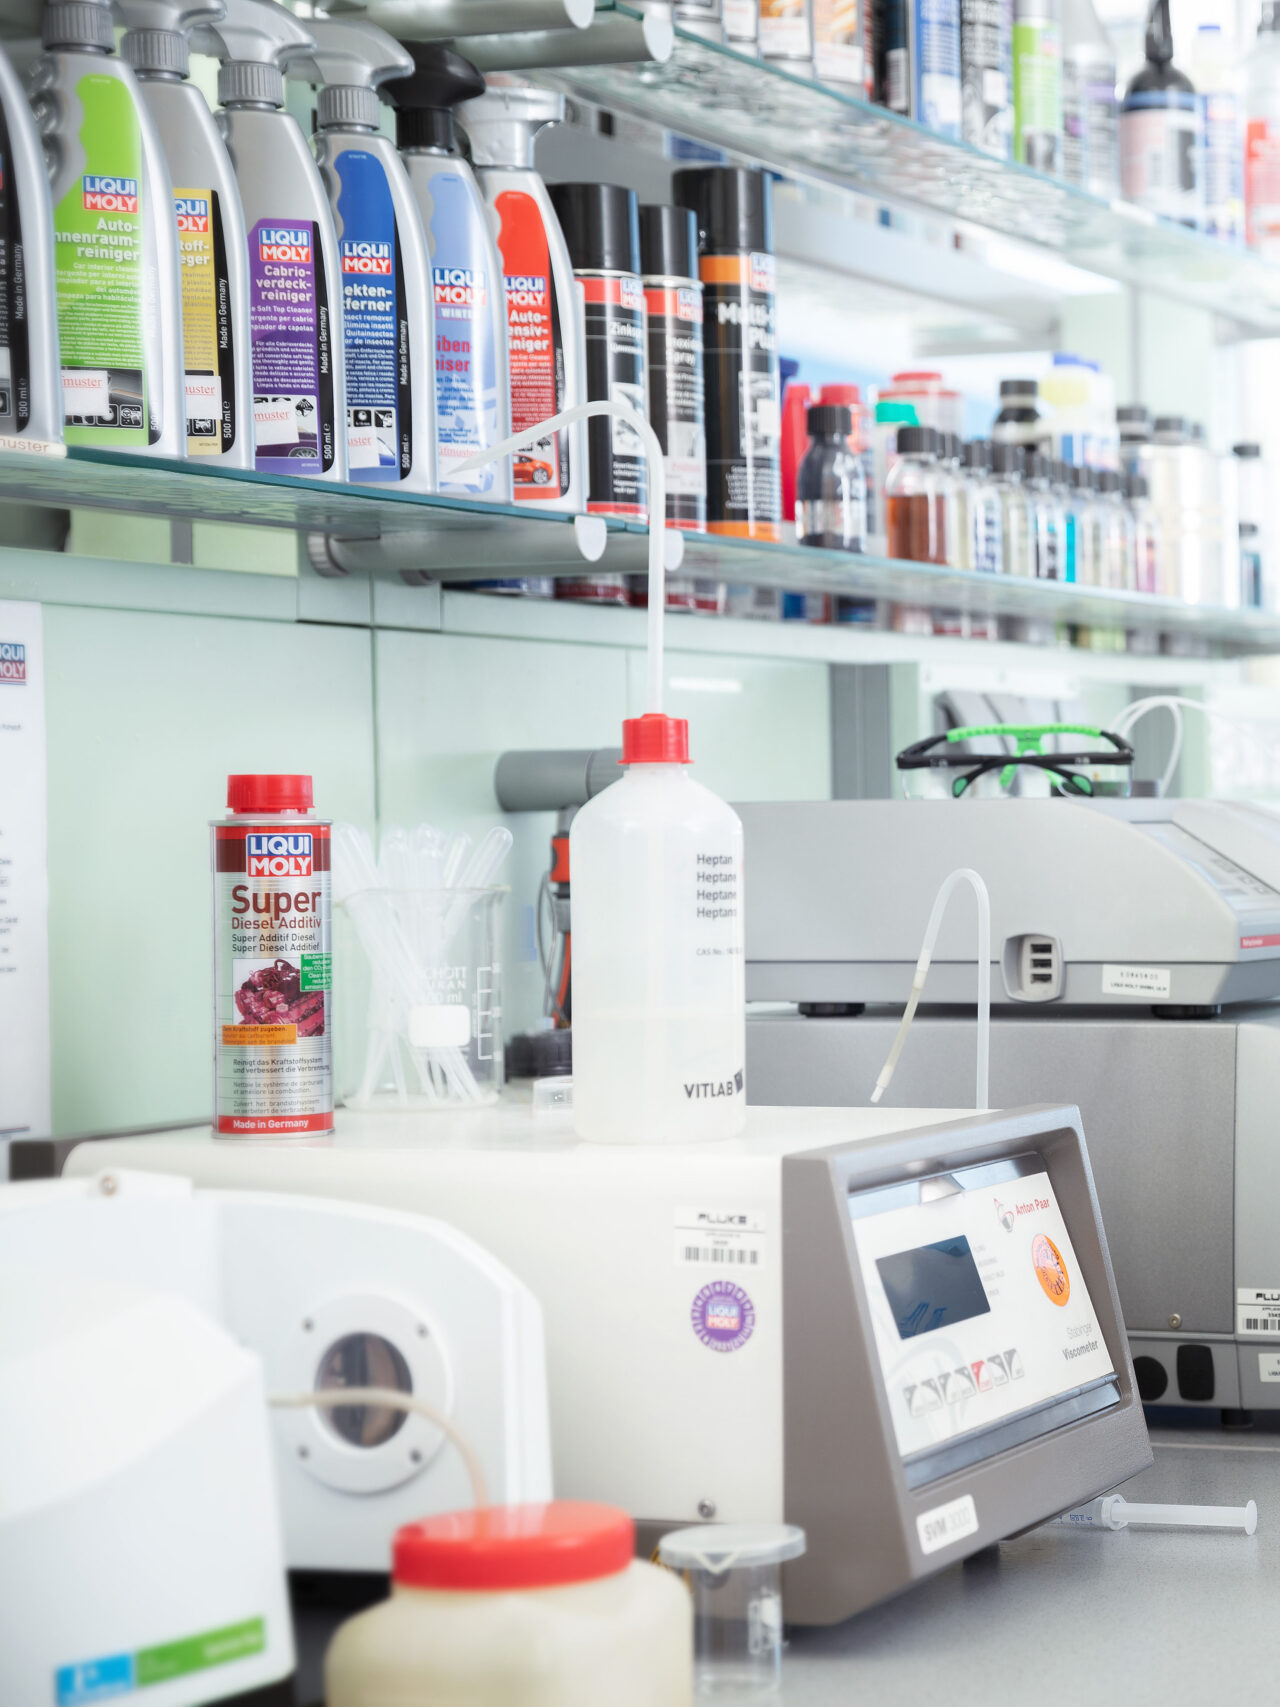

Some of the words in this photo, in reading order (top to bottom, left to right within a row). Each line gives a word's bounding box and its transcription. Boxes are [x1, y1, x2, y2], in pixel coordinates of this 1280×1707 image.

[85, 176, 136, 195] LIQUI
[86, 194, 136, 212] MOLY
[174, 200, 206, 216] QUI
[96, 218, 140, 232] Auto-
[176, 216, 207, 232] OLY
[54, 232, 140, 247] nnenraum-
[262, 230, 308, 246] LIQUI
[180, 240, 210, 252] toff-
[262, 246, 308, 261] MOLY
[344, 242, 389, 258] LIQUI
[77, 246, 142, 262] reiniger
[180, 254, 210, 266] eger
[14, 243, 24, 284] Germany
[344, 258, 390, 272] MOLY
[264, 265, 311, 278] Cabrio-
[15, 286, 23, 296] in
[256, 278, 312, 290] verdeck-
[344, 284, 392, 298] ekten-
[504, 276, 544, 291] LIQUI
[218, 278, 227, 316] Germany
[261, 289, 312, 304] reiniger
[15, 300, 24, 320] Made
[345, 298, 393, 311] ferner
[219, 317, 227, 325] in
[319, 306, 328, 341] Germany
[510, 310, 548, 323] Auto-
[220, 326, 228, 348] Made
[399, 320, 408, 354] Germany
[508, 324, 549, 338] ensiv-
[320, 342, 328, 350] in
[436, 335, 473, 352] iben-
[509, 337, 550, 353] iniger
[320, 351, 328, 374] Made
[399, 355, 407, 363] in
[436, 354, 470, 372] iser
[62, 376, 103, 387] muster
[400, 364, 408, 385] Made
[19, 401, 28, 418] 500
[223, 410, 231, 421] ml
[224, 423, 232, 438] 500
[324, 432, 331, 443] ml
[324, 444, 332, 460] 500
[0, 644, 25, 660] QUI
[250, 836, 310, 856] LIQUI
[250, 857, 311, 876] MOLY
[696, 854, 732, 868] Heptan
[232, 884, 322, 921] Super
[232, 916, 274, 930] Diesel
[278, 916, 322, 929] Additiv
[232, 934, 257, 944] Super
[259, 934, 290, 942] Additif
[292, 933, 316, 941] Diesel
[232, 944, 257, 954] Super
[260, 944, 288, 952] Diesel
[290, 942, 320, 951] Additief
[233, 1058, 256, 1066] Reinigt
[684, 1081, 733, 1098] VITLAB
[233, 1120, 256, 1129] Made
[257, 1120, 266, 1128] in
[268, 1120, 309, 1129] Germany
[1016, 1202, 1036, 1216] Anton
[1034, 1199, 1050, 1212] Paar
[698, 1213, 747, 1225] FLUKE
[1062, 1340, 1099, 1361] Viscometer
